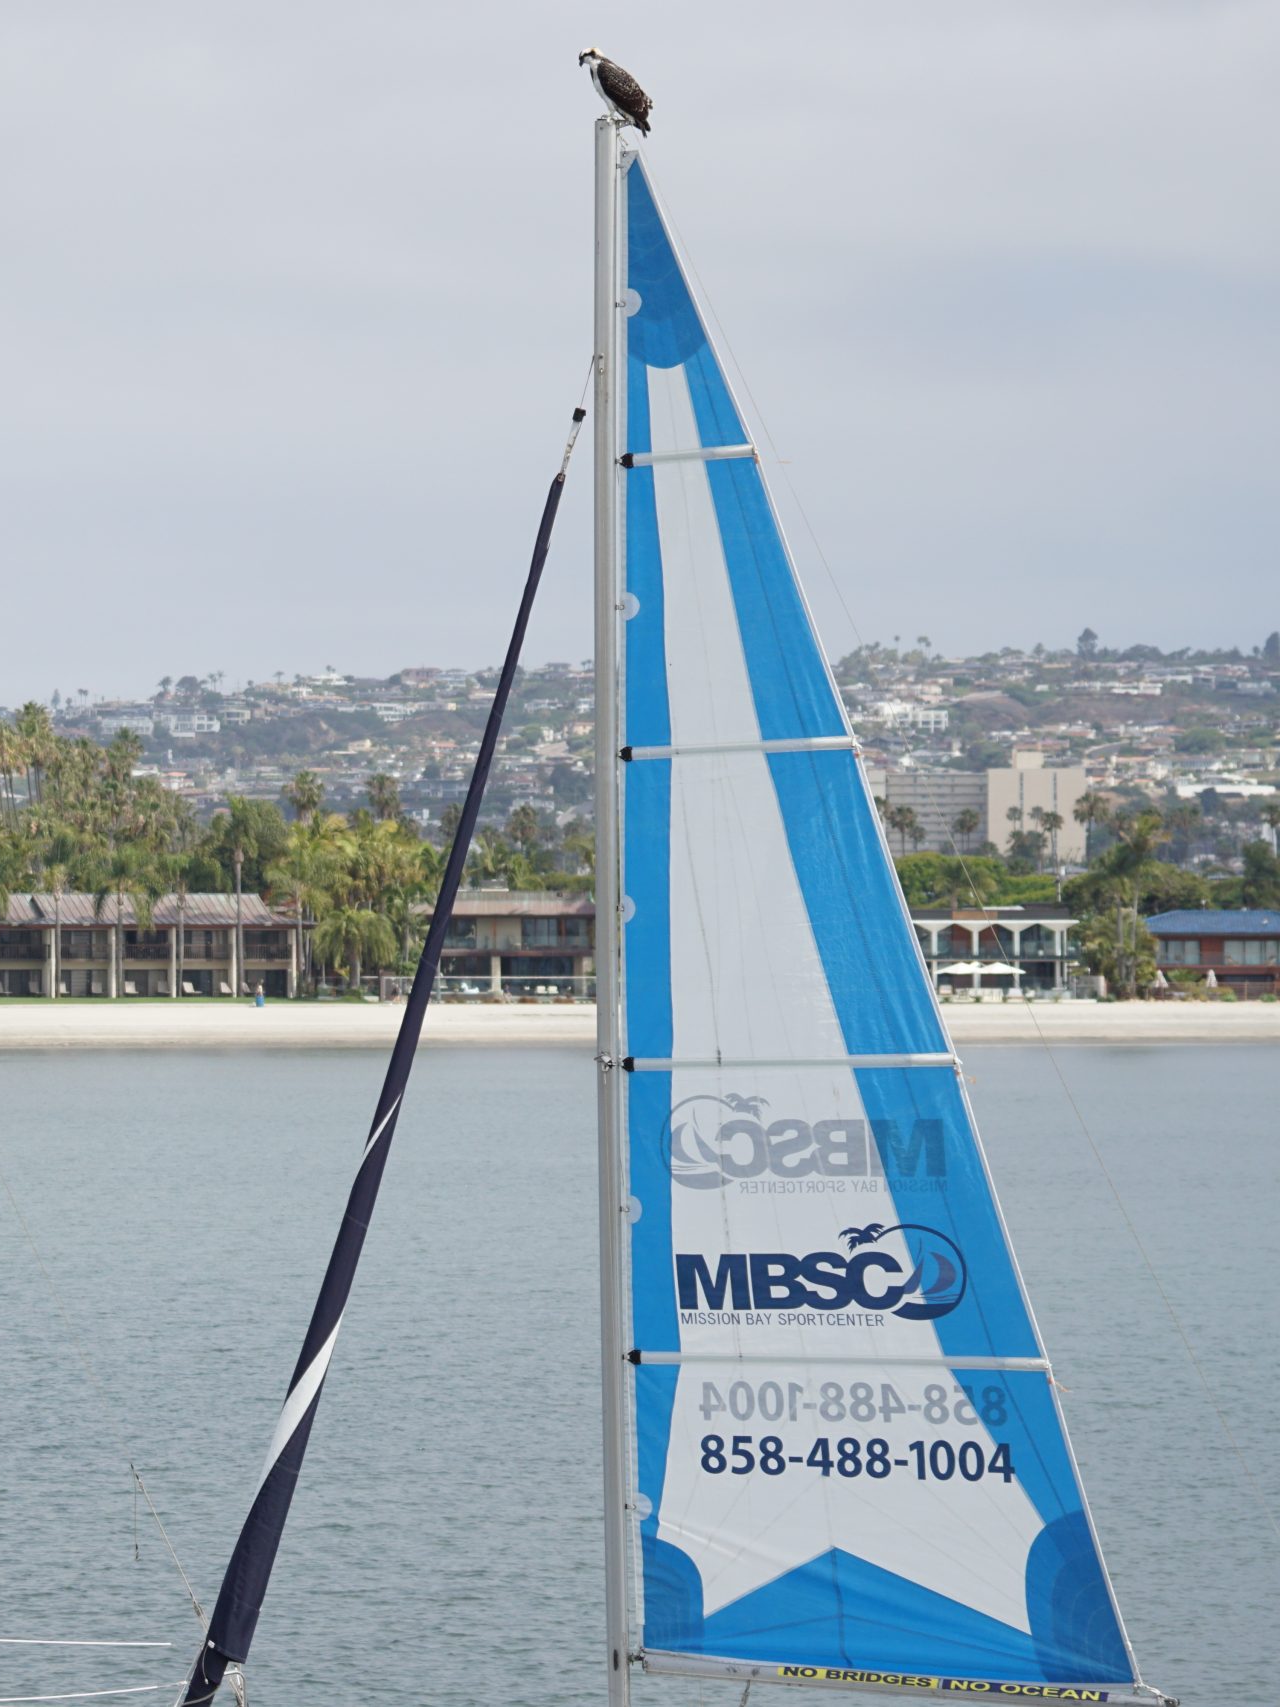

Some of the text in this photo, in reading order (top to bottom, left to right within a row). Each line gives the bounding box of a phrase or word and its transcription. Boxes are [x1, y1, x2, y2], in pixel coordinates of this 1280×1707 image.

[676, 1251, 906, 1311] MBSC
[681, 1312, 885, 1327] MISSION BAY SPORTCENTER
[700, 1434, 1015, 1483] 858-488-1004
[783, 1666, 931, 1687] NO BRIDGES
[950, 1679, 1101, 1701] NO OCEAN
